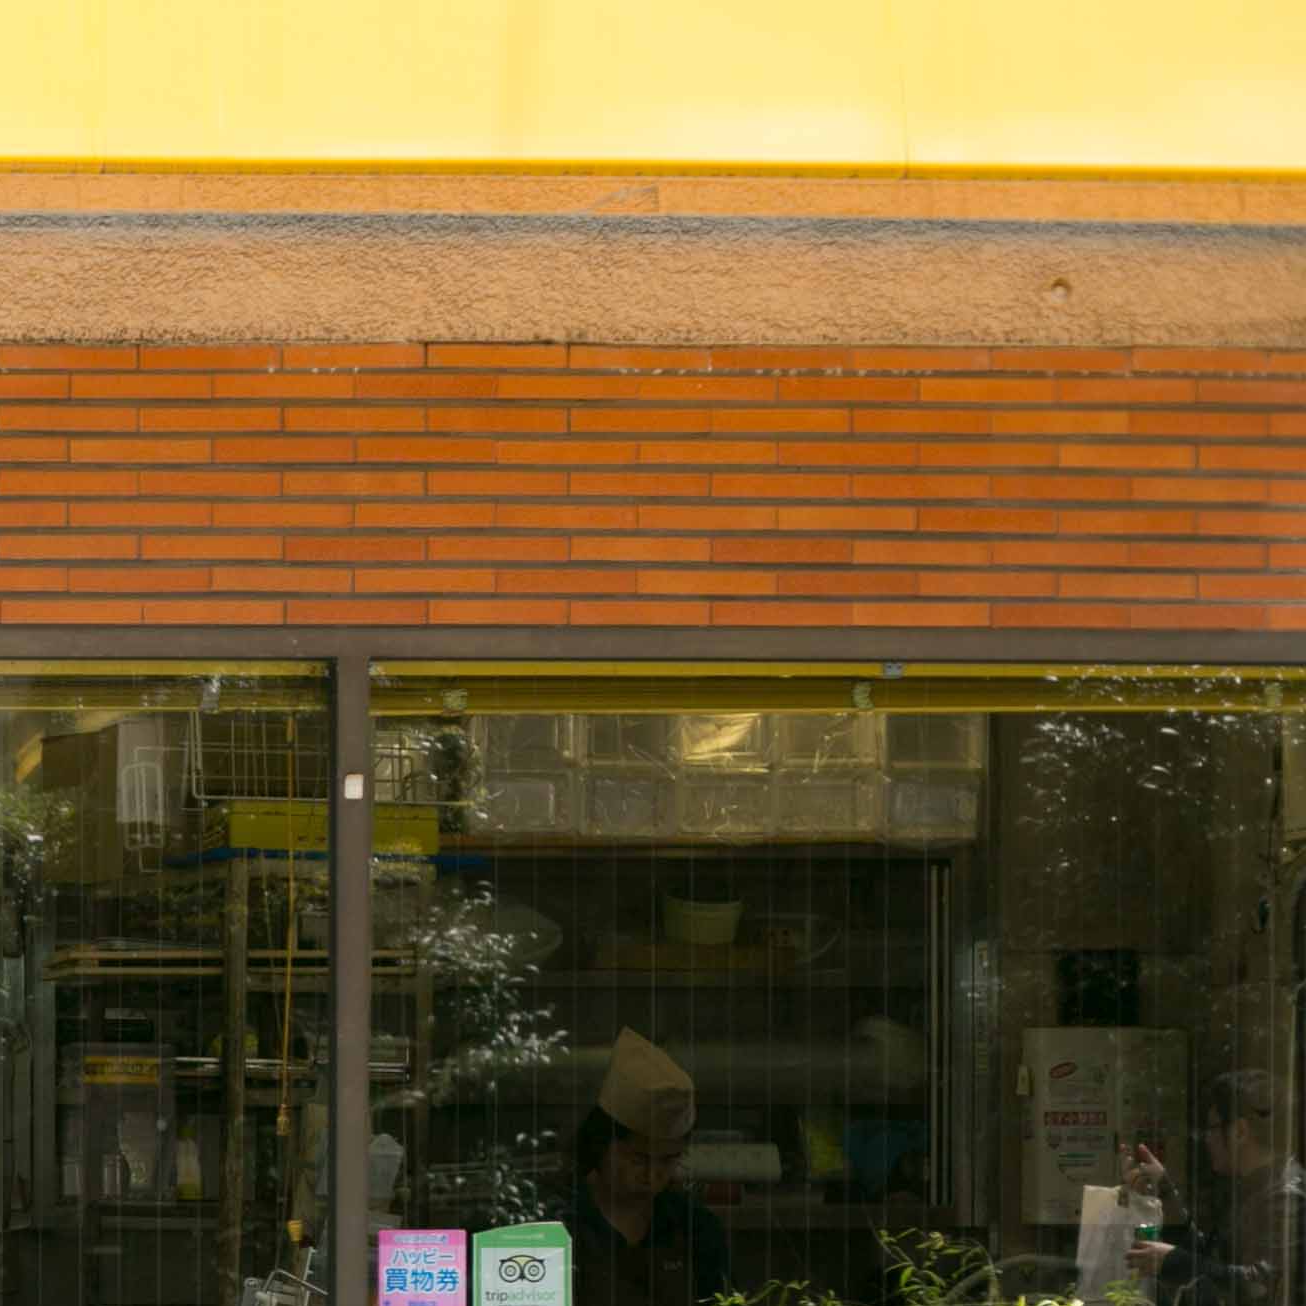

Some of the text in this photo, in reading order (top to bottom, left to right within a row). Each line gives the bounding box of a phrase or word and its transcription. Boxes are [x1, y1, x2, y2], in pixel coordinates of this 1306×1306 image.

[392, 1249, 454, 1265] ハッピー
[384, 1268, 460, 1292] 買物券
